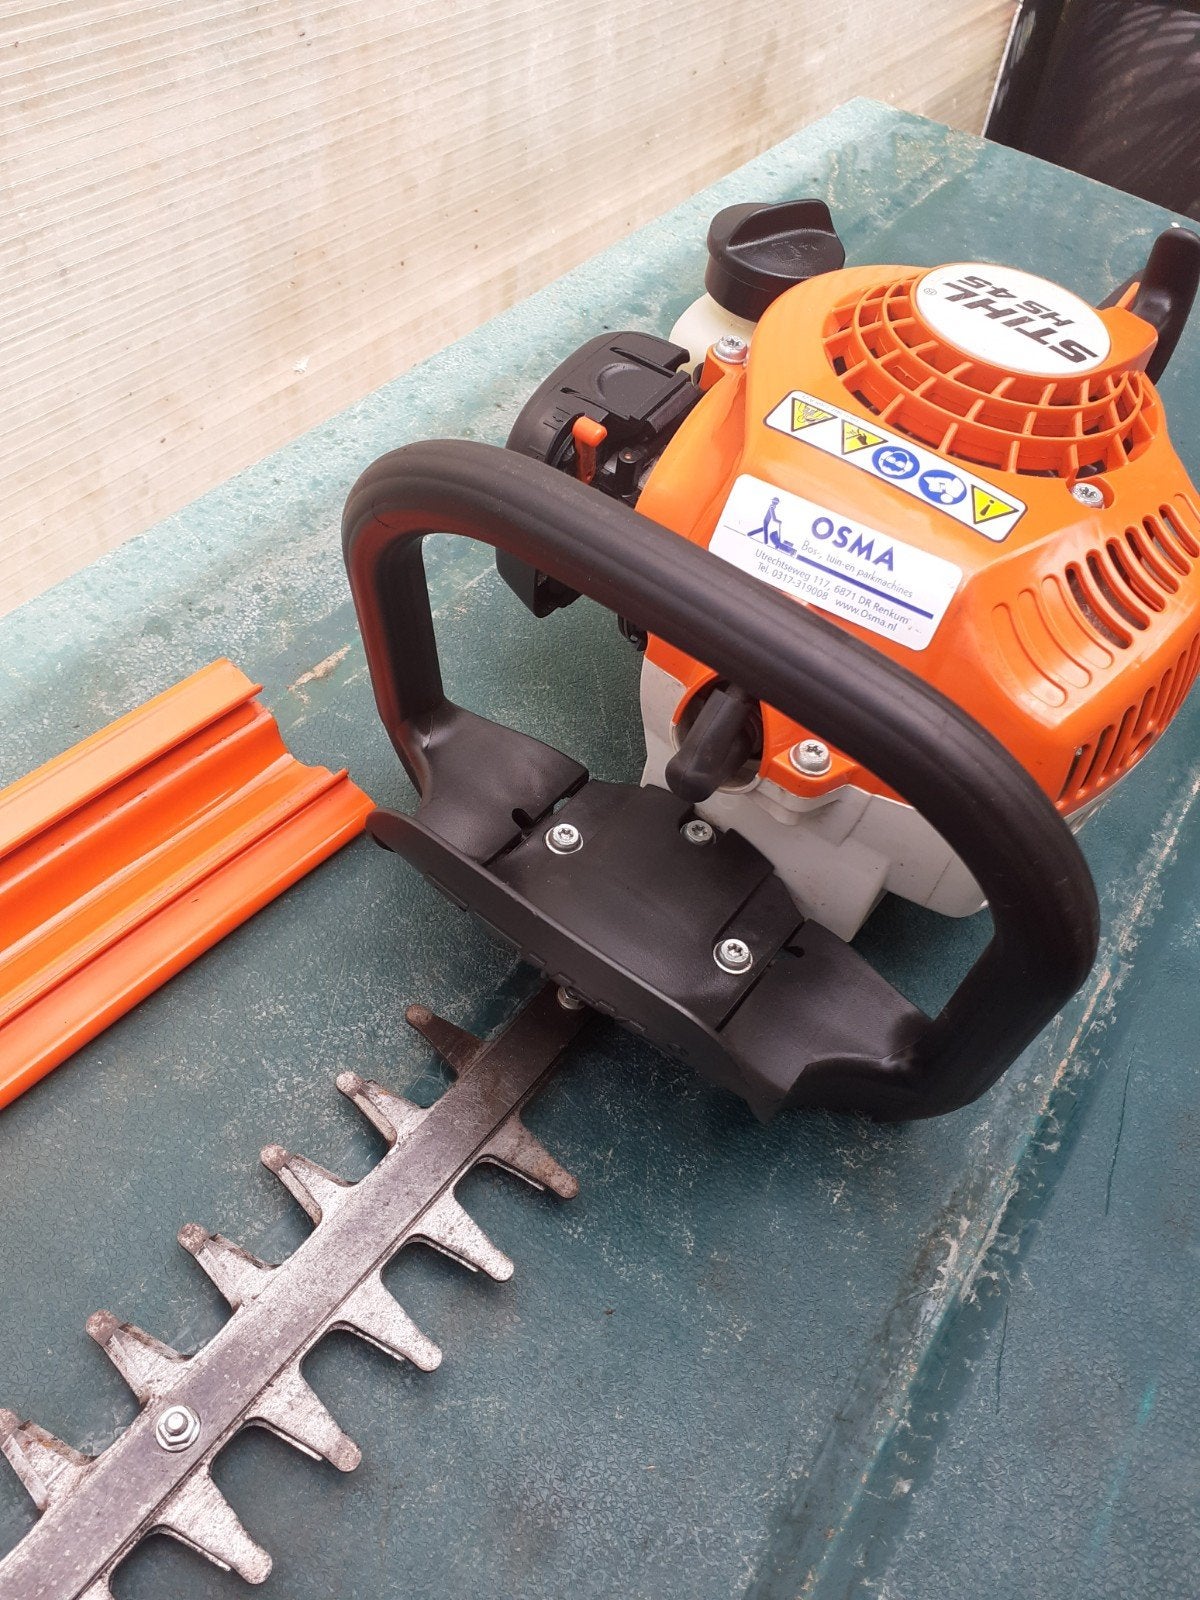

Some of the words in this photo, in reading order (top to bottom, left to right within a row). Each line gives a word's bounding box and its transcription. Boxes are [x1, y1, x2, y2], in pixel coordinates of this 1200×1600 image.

[958, 275, 1017, 299] 45
[1016, 300, 1075, 327] HS
[943, 282, 1099, 364] STIHL
[811, 516, 895, 572] OSMA
[755, 549, 810, 581] Utrechtseweg
[814, 576, 831, 591] 117,
[833, 585, 856, 599] 6871
[858, 595, 871, 607] DR
[872, 601, 908, 625] Renkum
[772, 569, 829, 601] 0317-319008
[835, 599, 898, 632] www.Osma.nl
[826, 554, 855, 573] tuin-en
[857, 568, 913, 598] parkmachines
